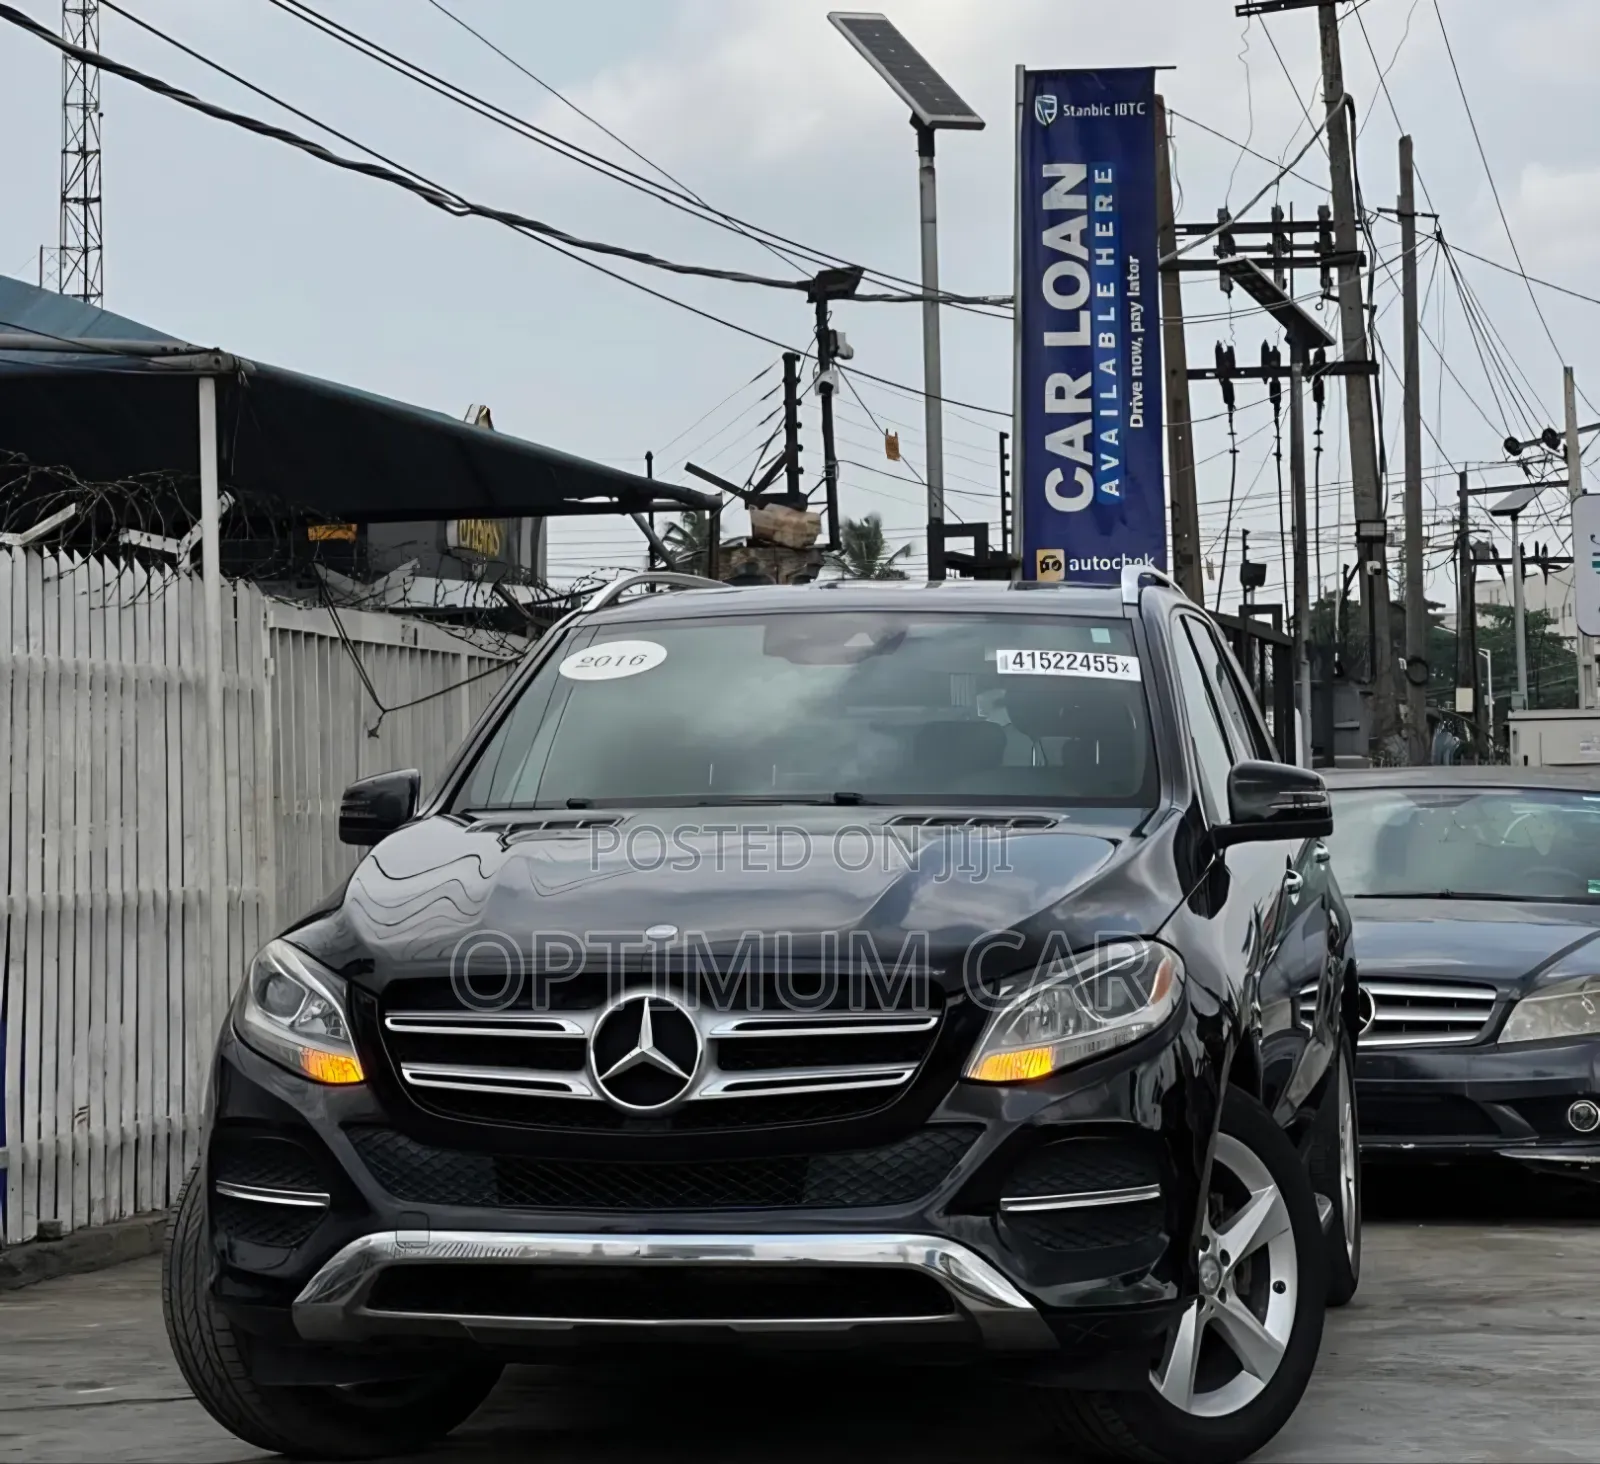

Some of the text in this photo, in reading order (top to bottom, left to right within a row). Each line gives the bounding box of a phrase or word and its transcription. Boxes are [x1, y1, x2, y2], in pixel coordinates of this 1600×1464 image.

[1063, 102, 1146, 117] Stanbic IBTC
[1042, 163, 1094, 512] CAR LOAN
[1094, 168, 1120, 497] AVAILABLE HERE
[1131, 337, 1144, 377] now,
[1129, 381, 1144, 428] Drive
[575, 654, 648, 669] 2016
